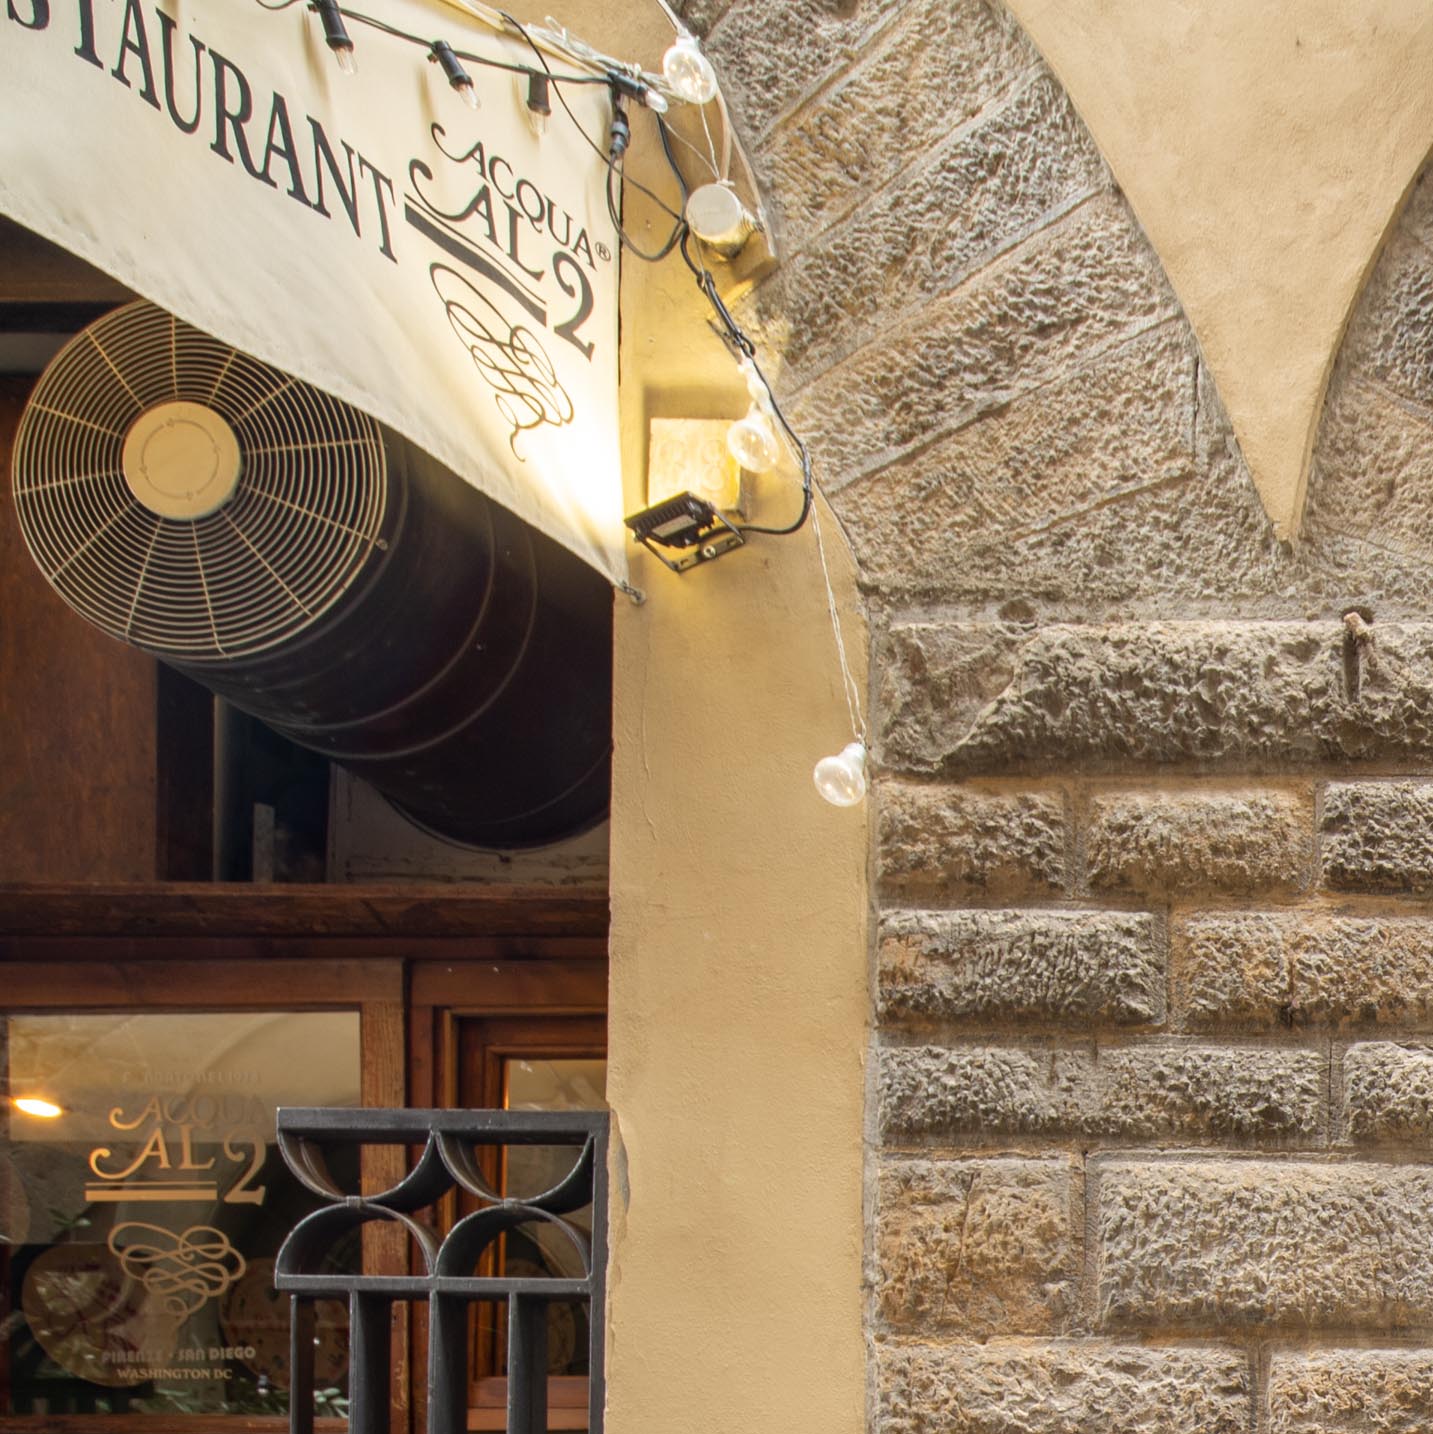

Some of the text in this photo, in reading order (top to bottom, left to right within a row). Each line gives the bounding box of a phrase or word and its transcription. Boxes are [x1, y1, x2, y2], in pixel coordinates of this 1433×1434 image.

[406, 157, 596, 362] AL 2
[109, 1094, 269, 1131] ACQUA
[89, 1123, 267, 1206] AL 2
[178, 1347, 206, 1361] SAN
[209, 1345, 257, 1360] DIEGO
[116, 1368, 233, 1380] WASHINGTON DC
